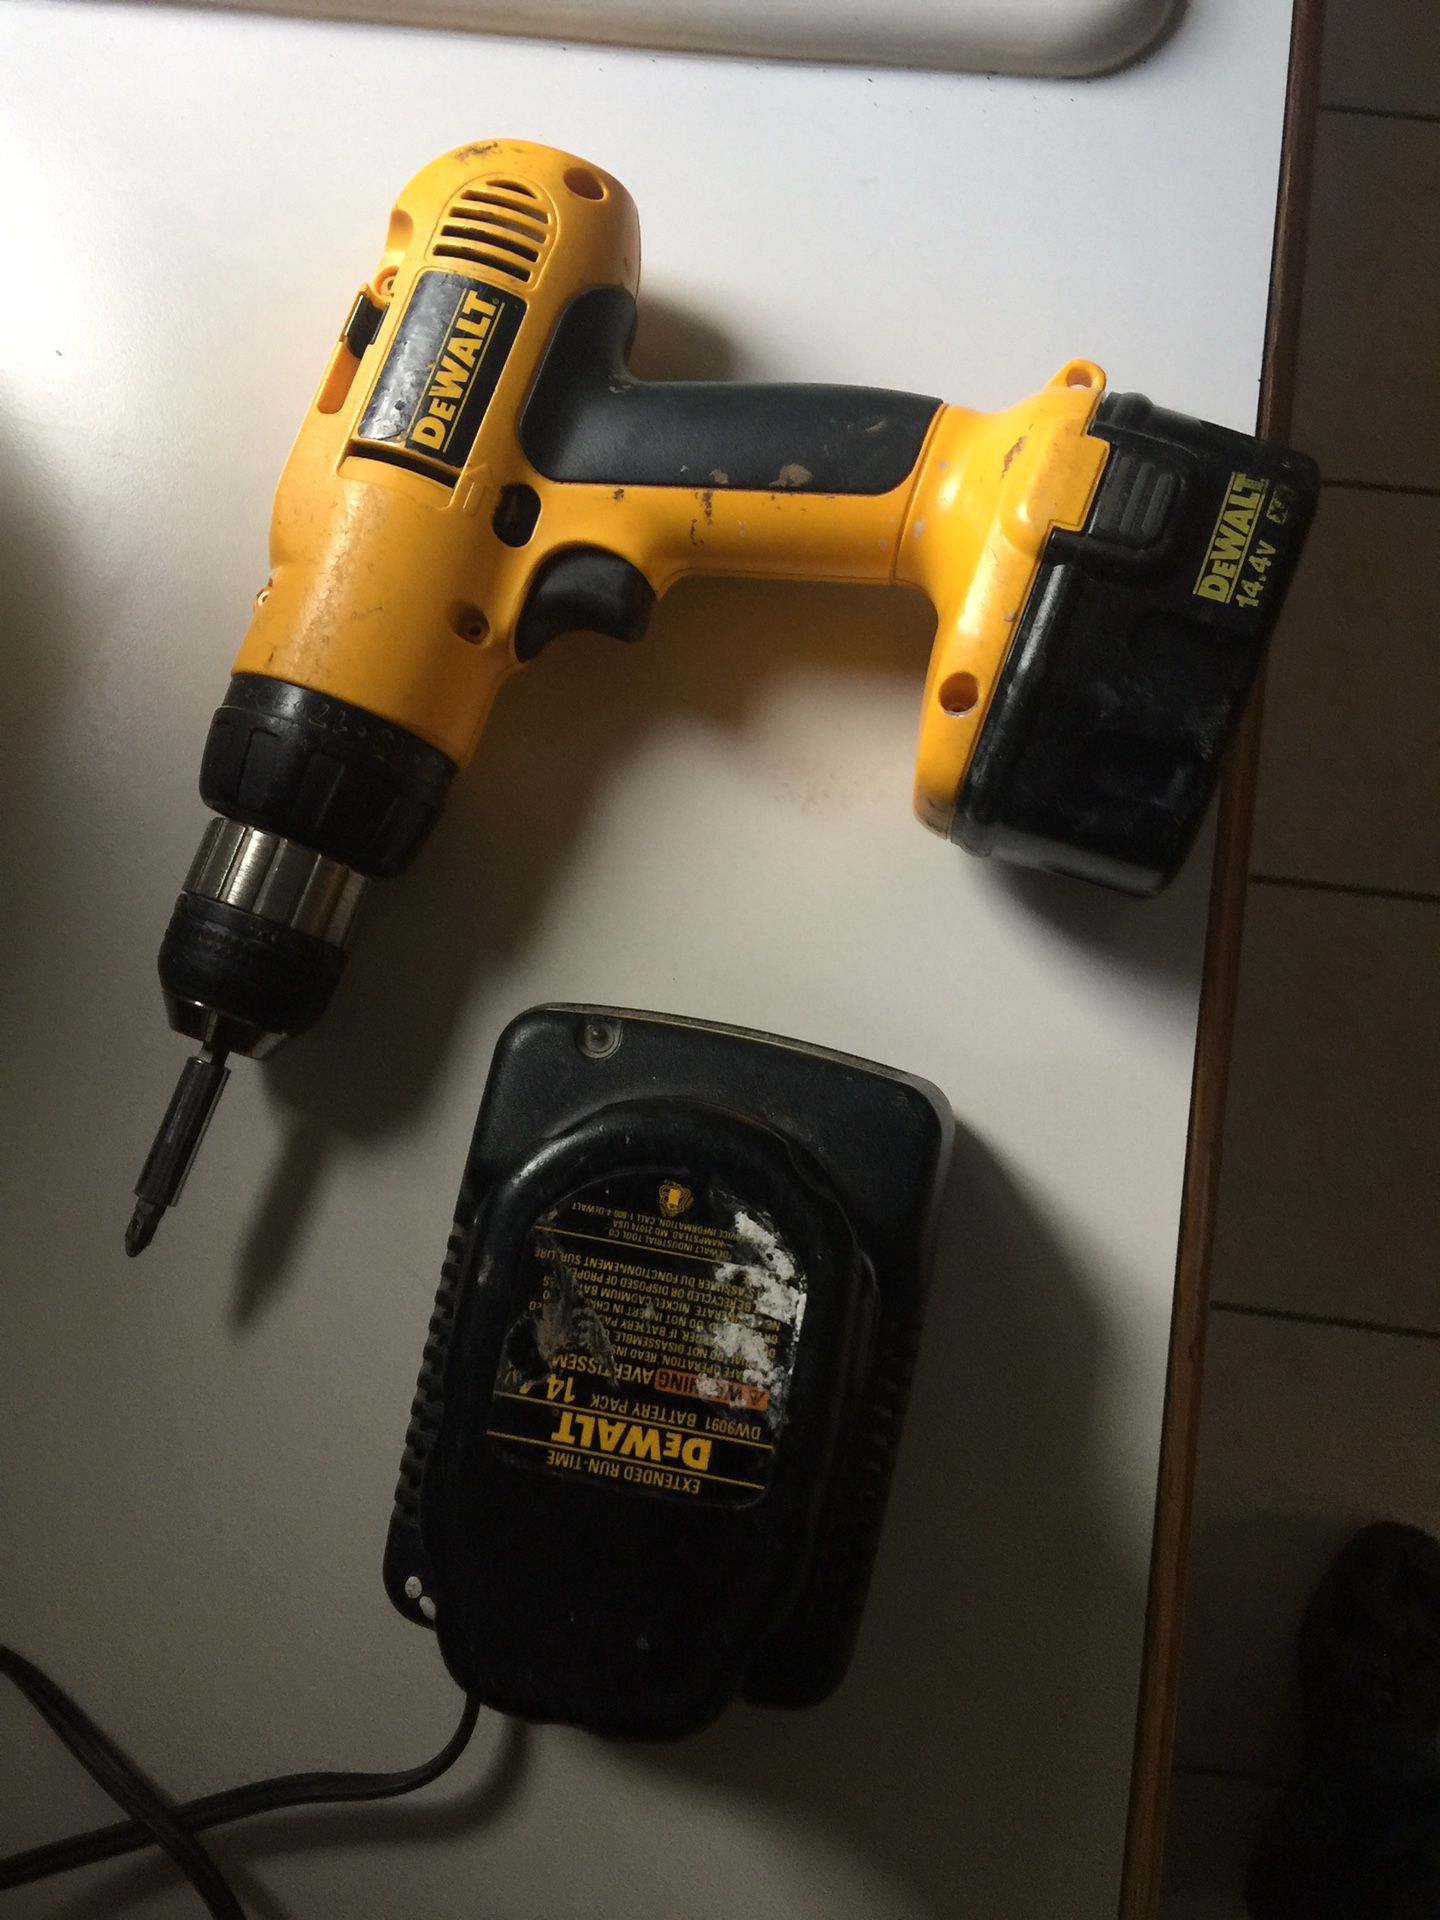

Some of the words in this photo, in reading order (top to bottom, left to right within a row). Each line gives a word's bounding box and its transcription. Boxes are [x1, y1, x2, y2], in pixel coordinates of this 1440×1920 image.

[1236, 540, 1277, 608] 14.4V
[636, 1214, 656, 1225] CALL
[622, 1231, 643, 1242] TOOL
[643, 1235, 693, 1253] INDUSTRIAL
[604, 1275, 618, 1286] OF
[619, 1277, 669, 1297] DISPOSED
[681, 1275, 696, 1287] DU
[600, 1286, 652, 1306] CADMIUM
[670, 1287, 684, 1299] OR
[686, 1290, 736, 1309] RECYCLED
[612, 1303, 624, 1314] IN
[653, 1297, 690, 1313] NICKEL
[621, 1319, 666, 1336] BATTERY
[666, 1313, 687, 1326] NOT
[668, 1328, 678, 1338] IF
[629, 1349, 657, 1363] READ
[687, 1346, 707, 1358] NOT
[656, 1370, 746, 1405] WING
[590, 1393, 629, 1414] PACK
[633, 1402, 697, 1428] BATTERY
[704, 1416, 761, 1441] DW9091
[545, 1450, 620, 1478] RUN-TIME
[623, 1465, 701, 1494] EXTENDED
